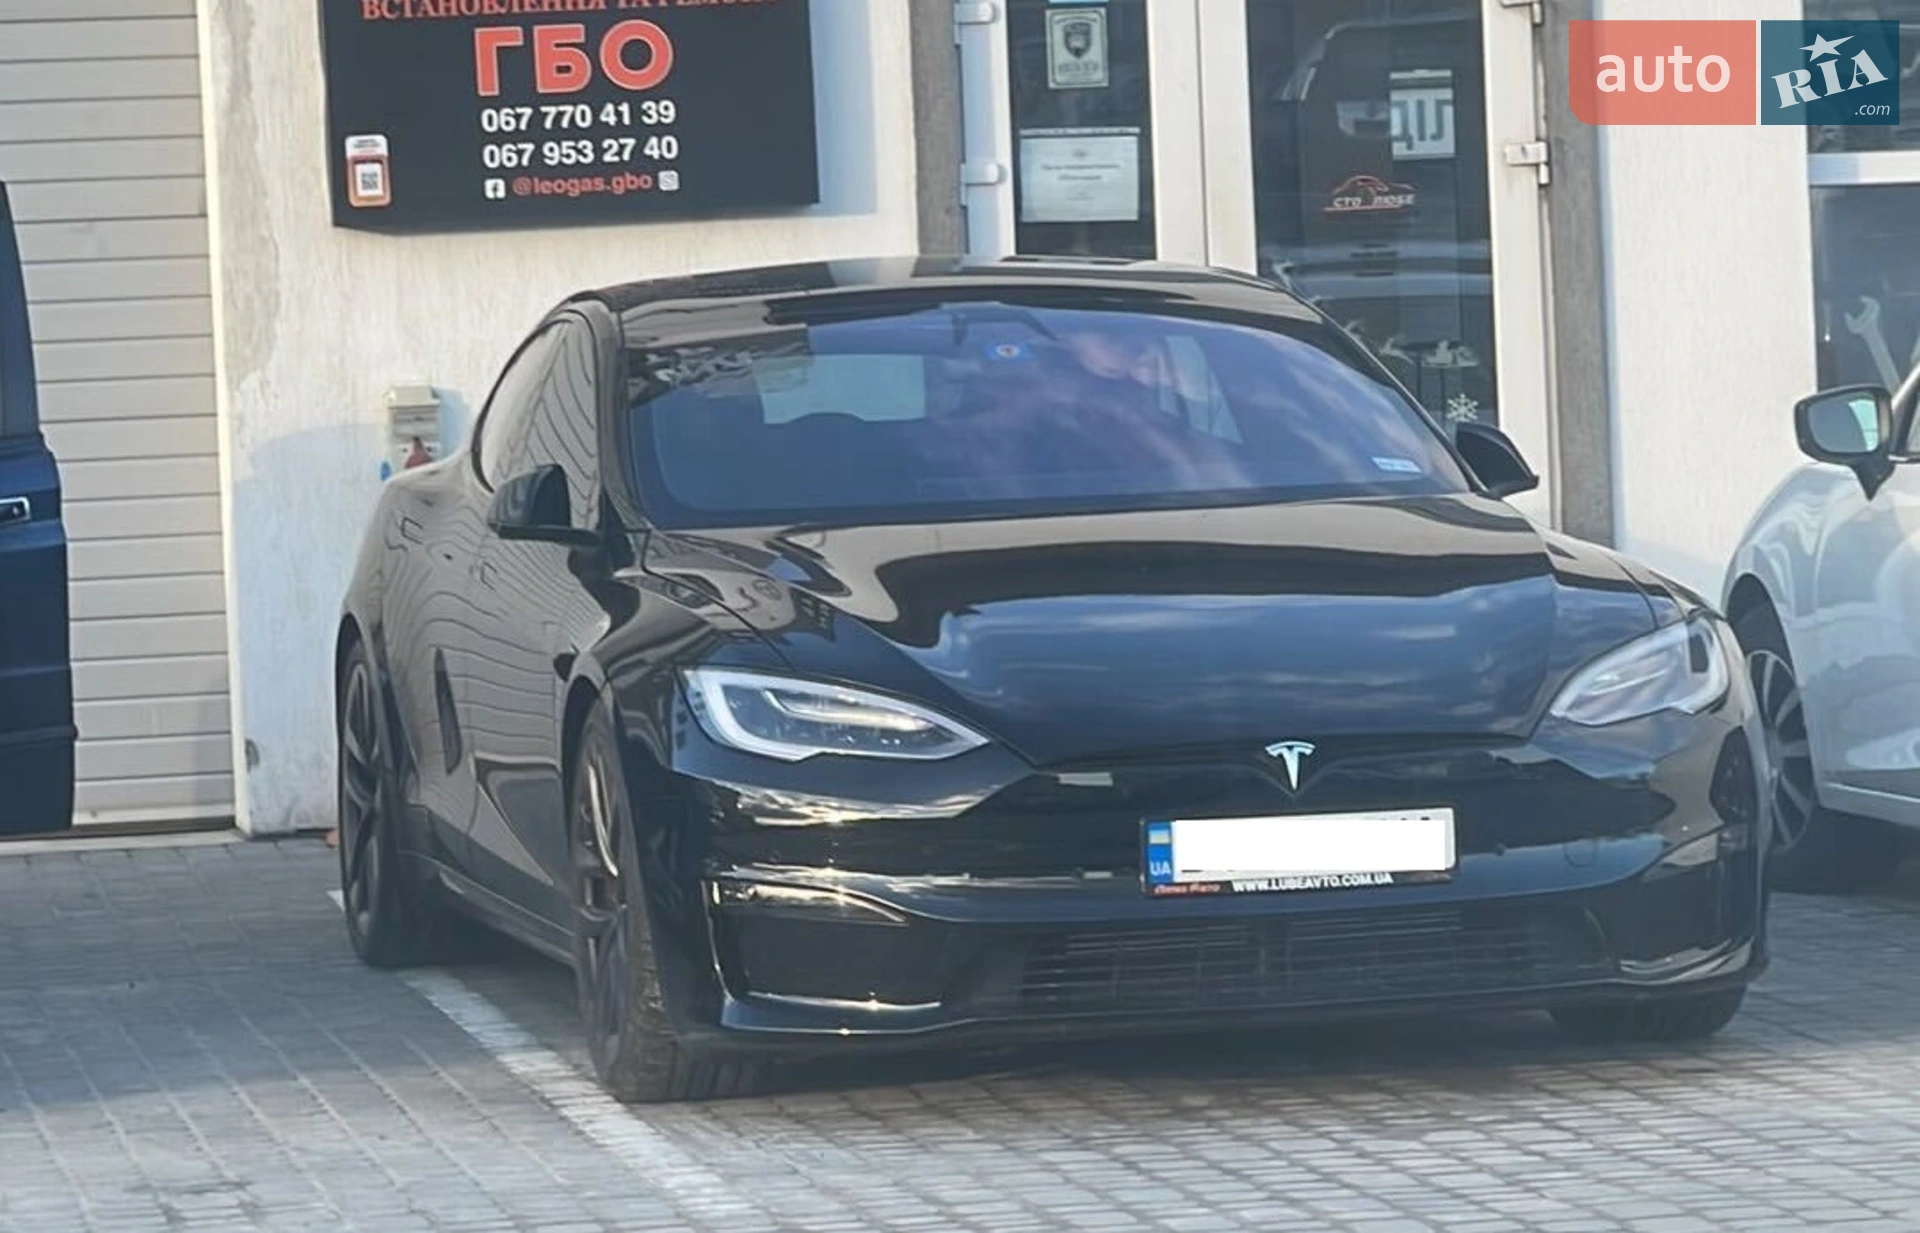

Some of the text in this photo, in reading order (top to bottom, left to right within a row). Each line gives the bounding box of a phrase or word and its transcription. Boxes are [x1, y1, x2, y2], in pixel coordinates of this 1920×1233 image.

[474, 19, 674, 96] ГБО
[481, 100, 676, 132] 067 770 41 39
[483, 135, 678, 169] 067 953 27 40
[512, 174, 653, 197] @leogas.gbo
[1149, 861, 1171, 876] UA
